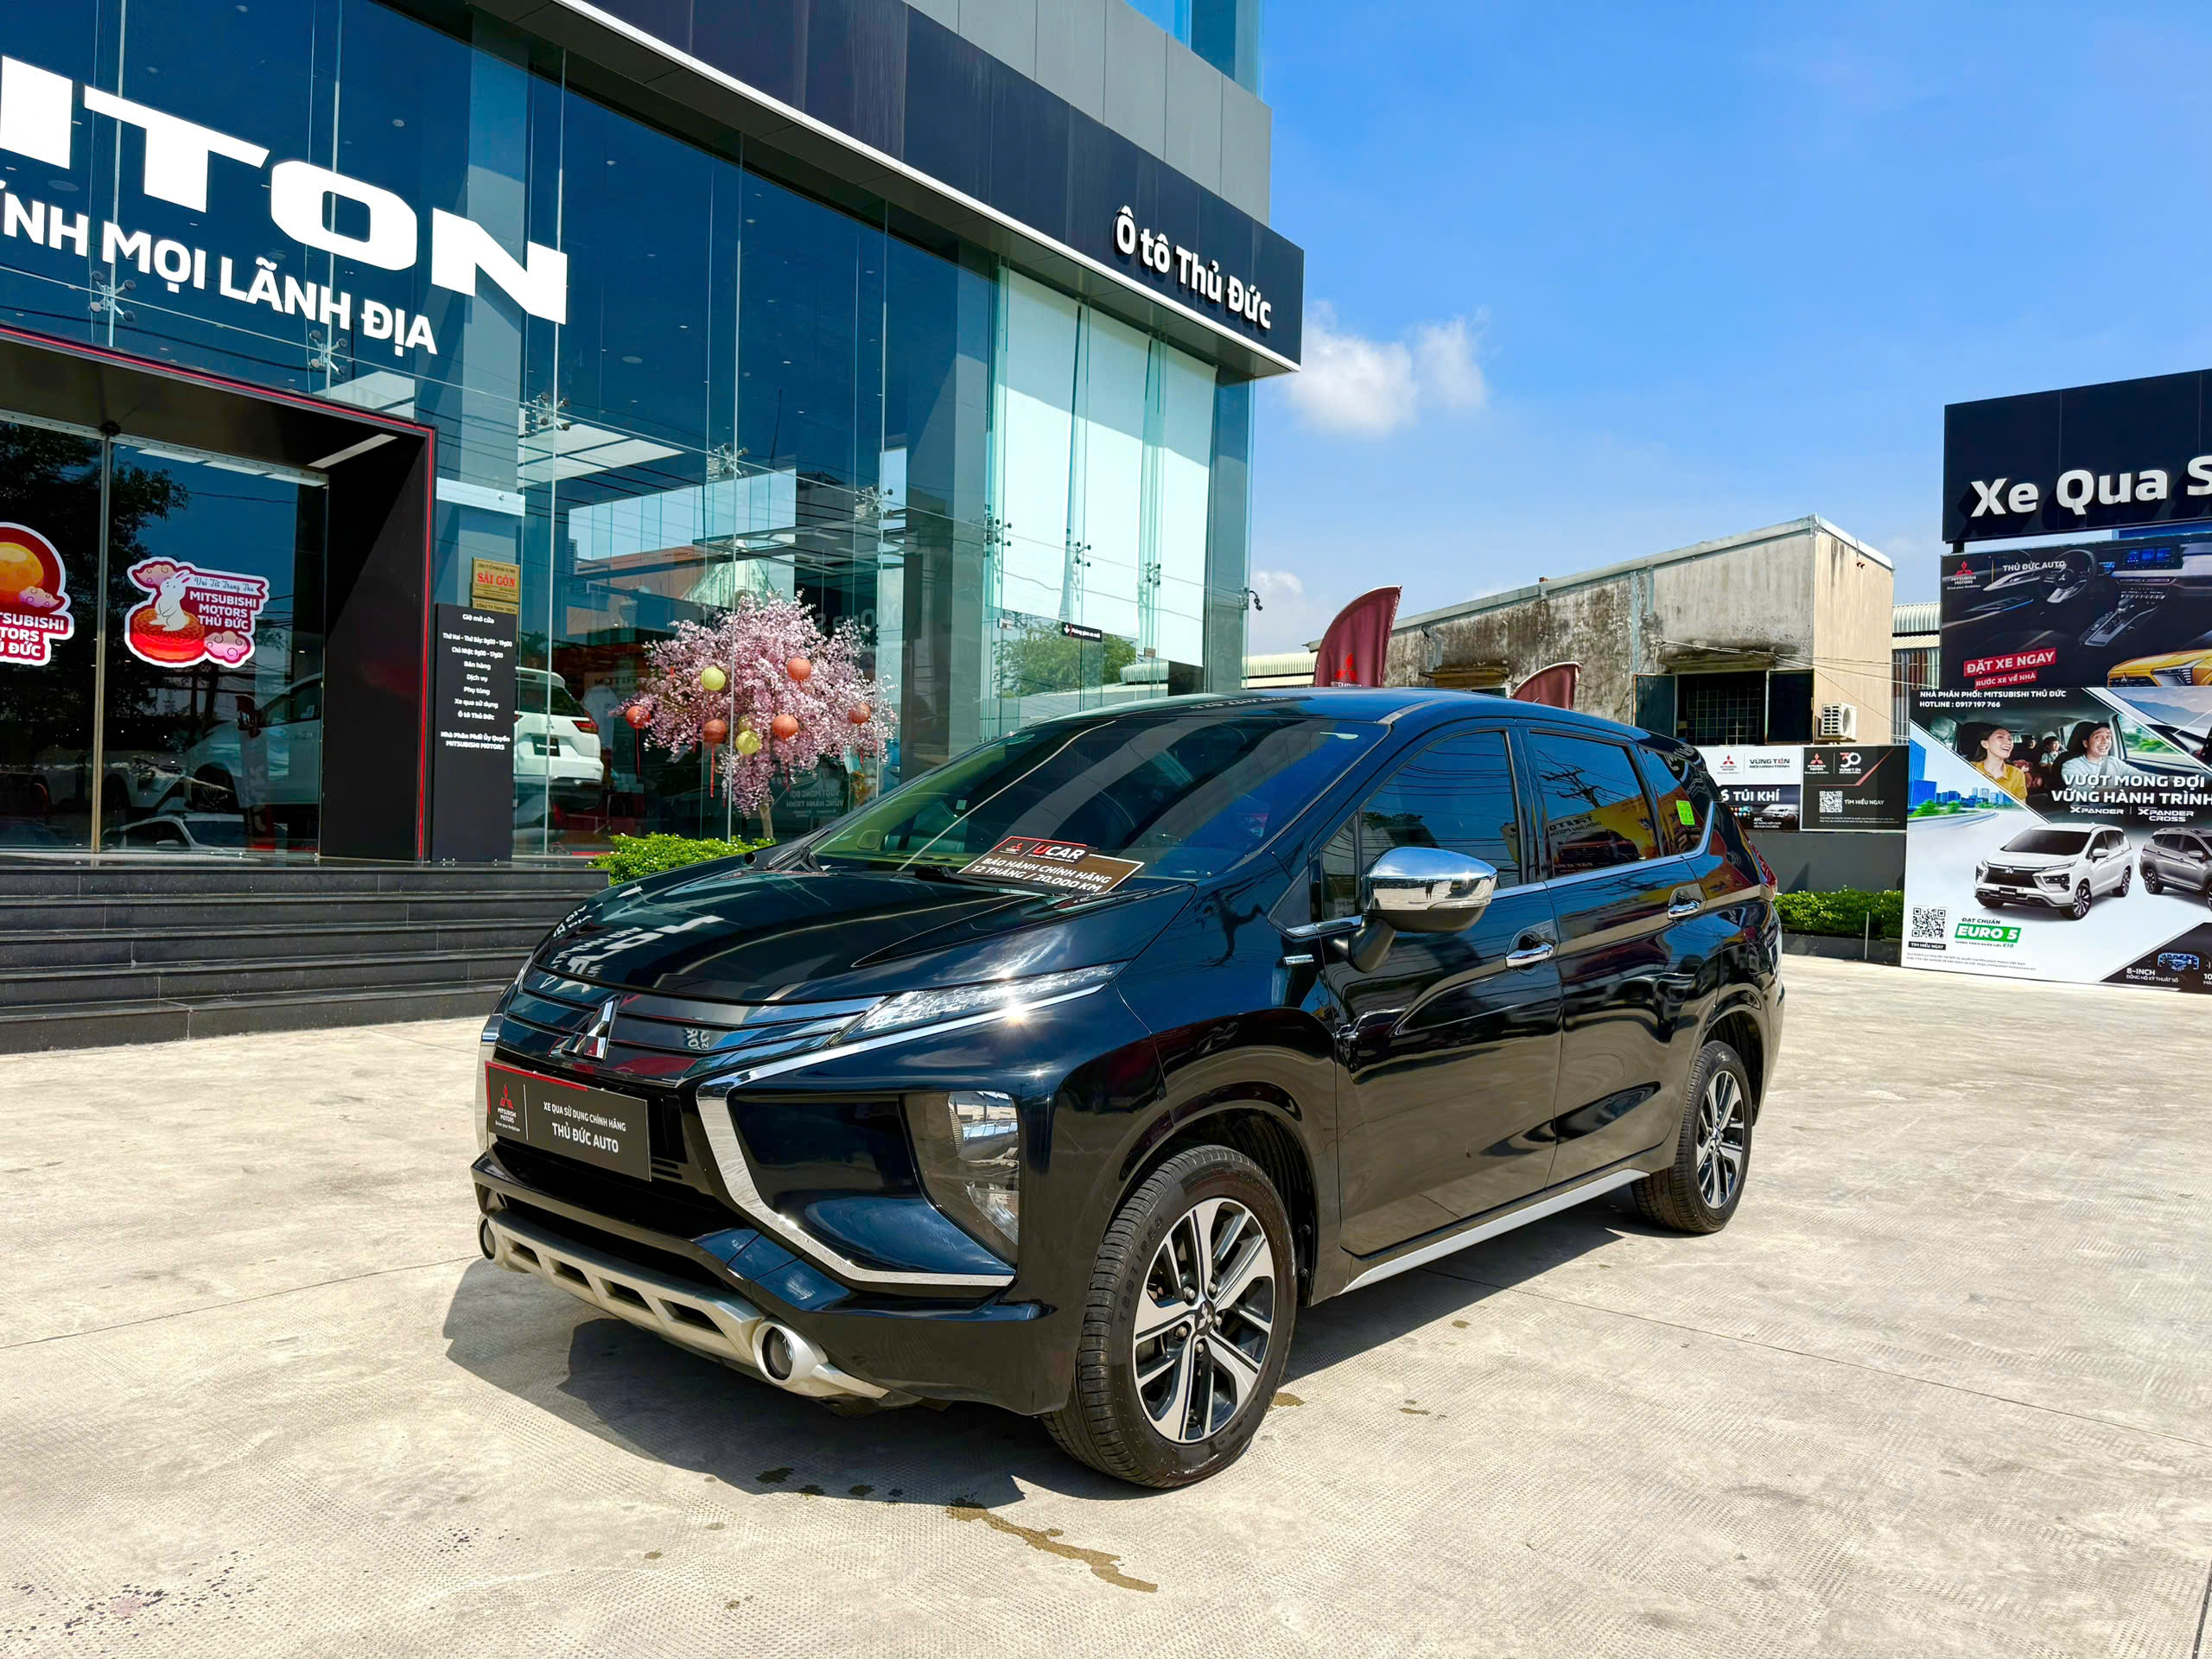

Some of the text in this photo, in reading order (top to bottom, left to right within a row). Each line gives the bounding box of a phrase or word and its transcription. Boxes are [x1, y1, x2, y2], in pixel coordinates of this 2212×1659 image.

[1115, 206, 1272, 329] Ô tô Thủ Đức
[103, 219, 206, 294] MỌI
[219, 257, 352, 331] LÃNH
[360, 298, 438, 356] ĐỊA
[1970, 478, 2038, 518] Xe
[2056, 469, 2168, 516] Qua
[2002, 560, 2066, 571] THỦ ĐỨC AUTO
[189, 591, 256, 607] MITSUBISHI
[199, 605, 248, 618] MOTORS
[197, 614, 249, 629] THỦ ĐỨC
[9, 640, 41, 657] ĐỨC
[1967, 652, 2056, 675] ĐẶT XE NGAY
[2019, 672, 2036, 681] NHÀ
[1961, 689, 1982, 697] PHỐI:
[2031, 689, 2048, 697] THỦ
[2064, 774, 2205, 791] VƯỢT MONG ĐỢI
[1732, 788, 1754, 802] TÚI
[1757, 788, 1781, 802] KHÍ
[2051, 788, 2100, 803] VỮNG
[2103, 789, 2155, 804] HÀNH
[2069, 805, 2195, 817] XPANDER XPANDER
[1033, 844, 1086, 861] UCAR
[981, 857, 1008, 867] BẢO
[1005, 859, 1040, 871] HÀNH
[1038, 864, 1077, 877] CHÍNH
[1073, 870, 1113, 884] HÃNG
[984, 866, 1026, 880] THÁNG
[1033, 874, 1081, 888] 20.000
[1077, 881, 1103, 893] KM
[1957, 925, 2018, 940] EURO 5
[543, 1101, 626, 1132] XE QUA SỬ DỤNG CHÍNH HÃNG
[551, 1121, 619, 1153] THỦ ĐỨC AUTO
